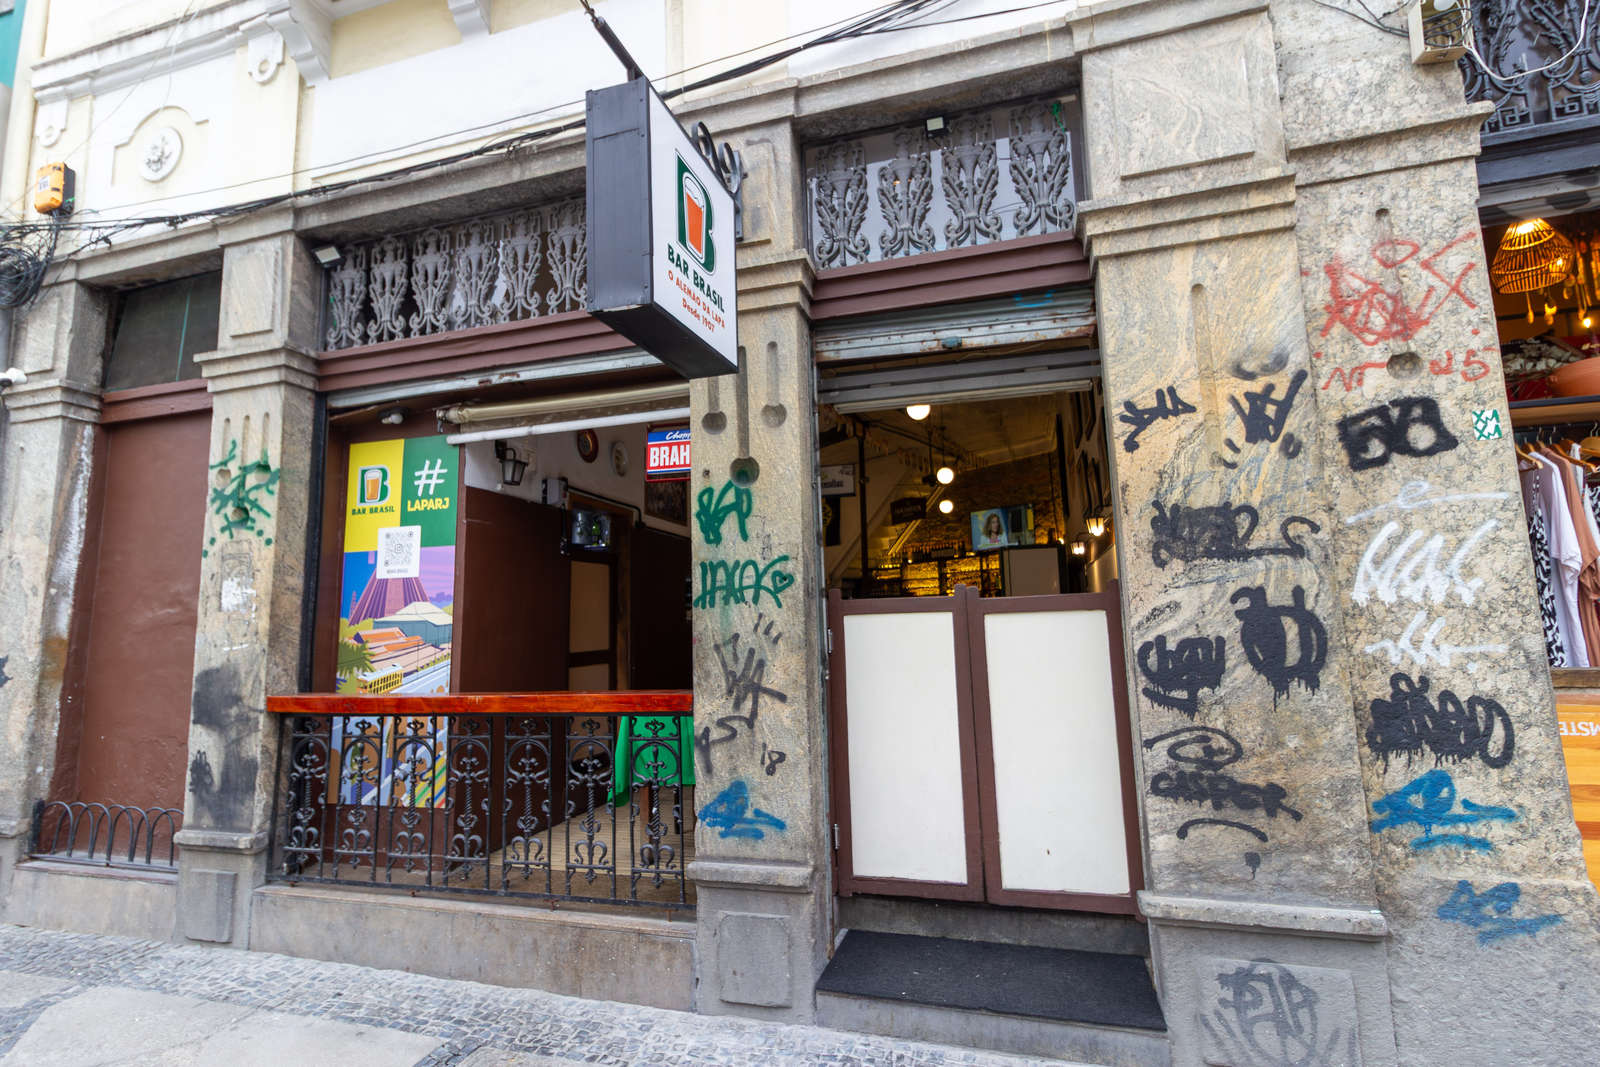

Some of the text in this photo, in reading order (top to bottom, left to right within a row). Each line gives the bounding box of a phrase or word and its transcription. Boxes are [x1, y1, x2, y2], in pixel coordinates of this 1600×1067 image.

[667, 243, 725, 314] BAR BRASIL
[667, 270, 674, 281] O
[702, 301, 711, 315] DA
[711, 310, 726, 329] LAPA
[682, 297, 715, 332] Desde 1907
[650, 444, 690, 467] BRAH
[351, 504, 395, 516] BAR BRASIL
[407, 496, 450, 512] LAPARJ
